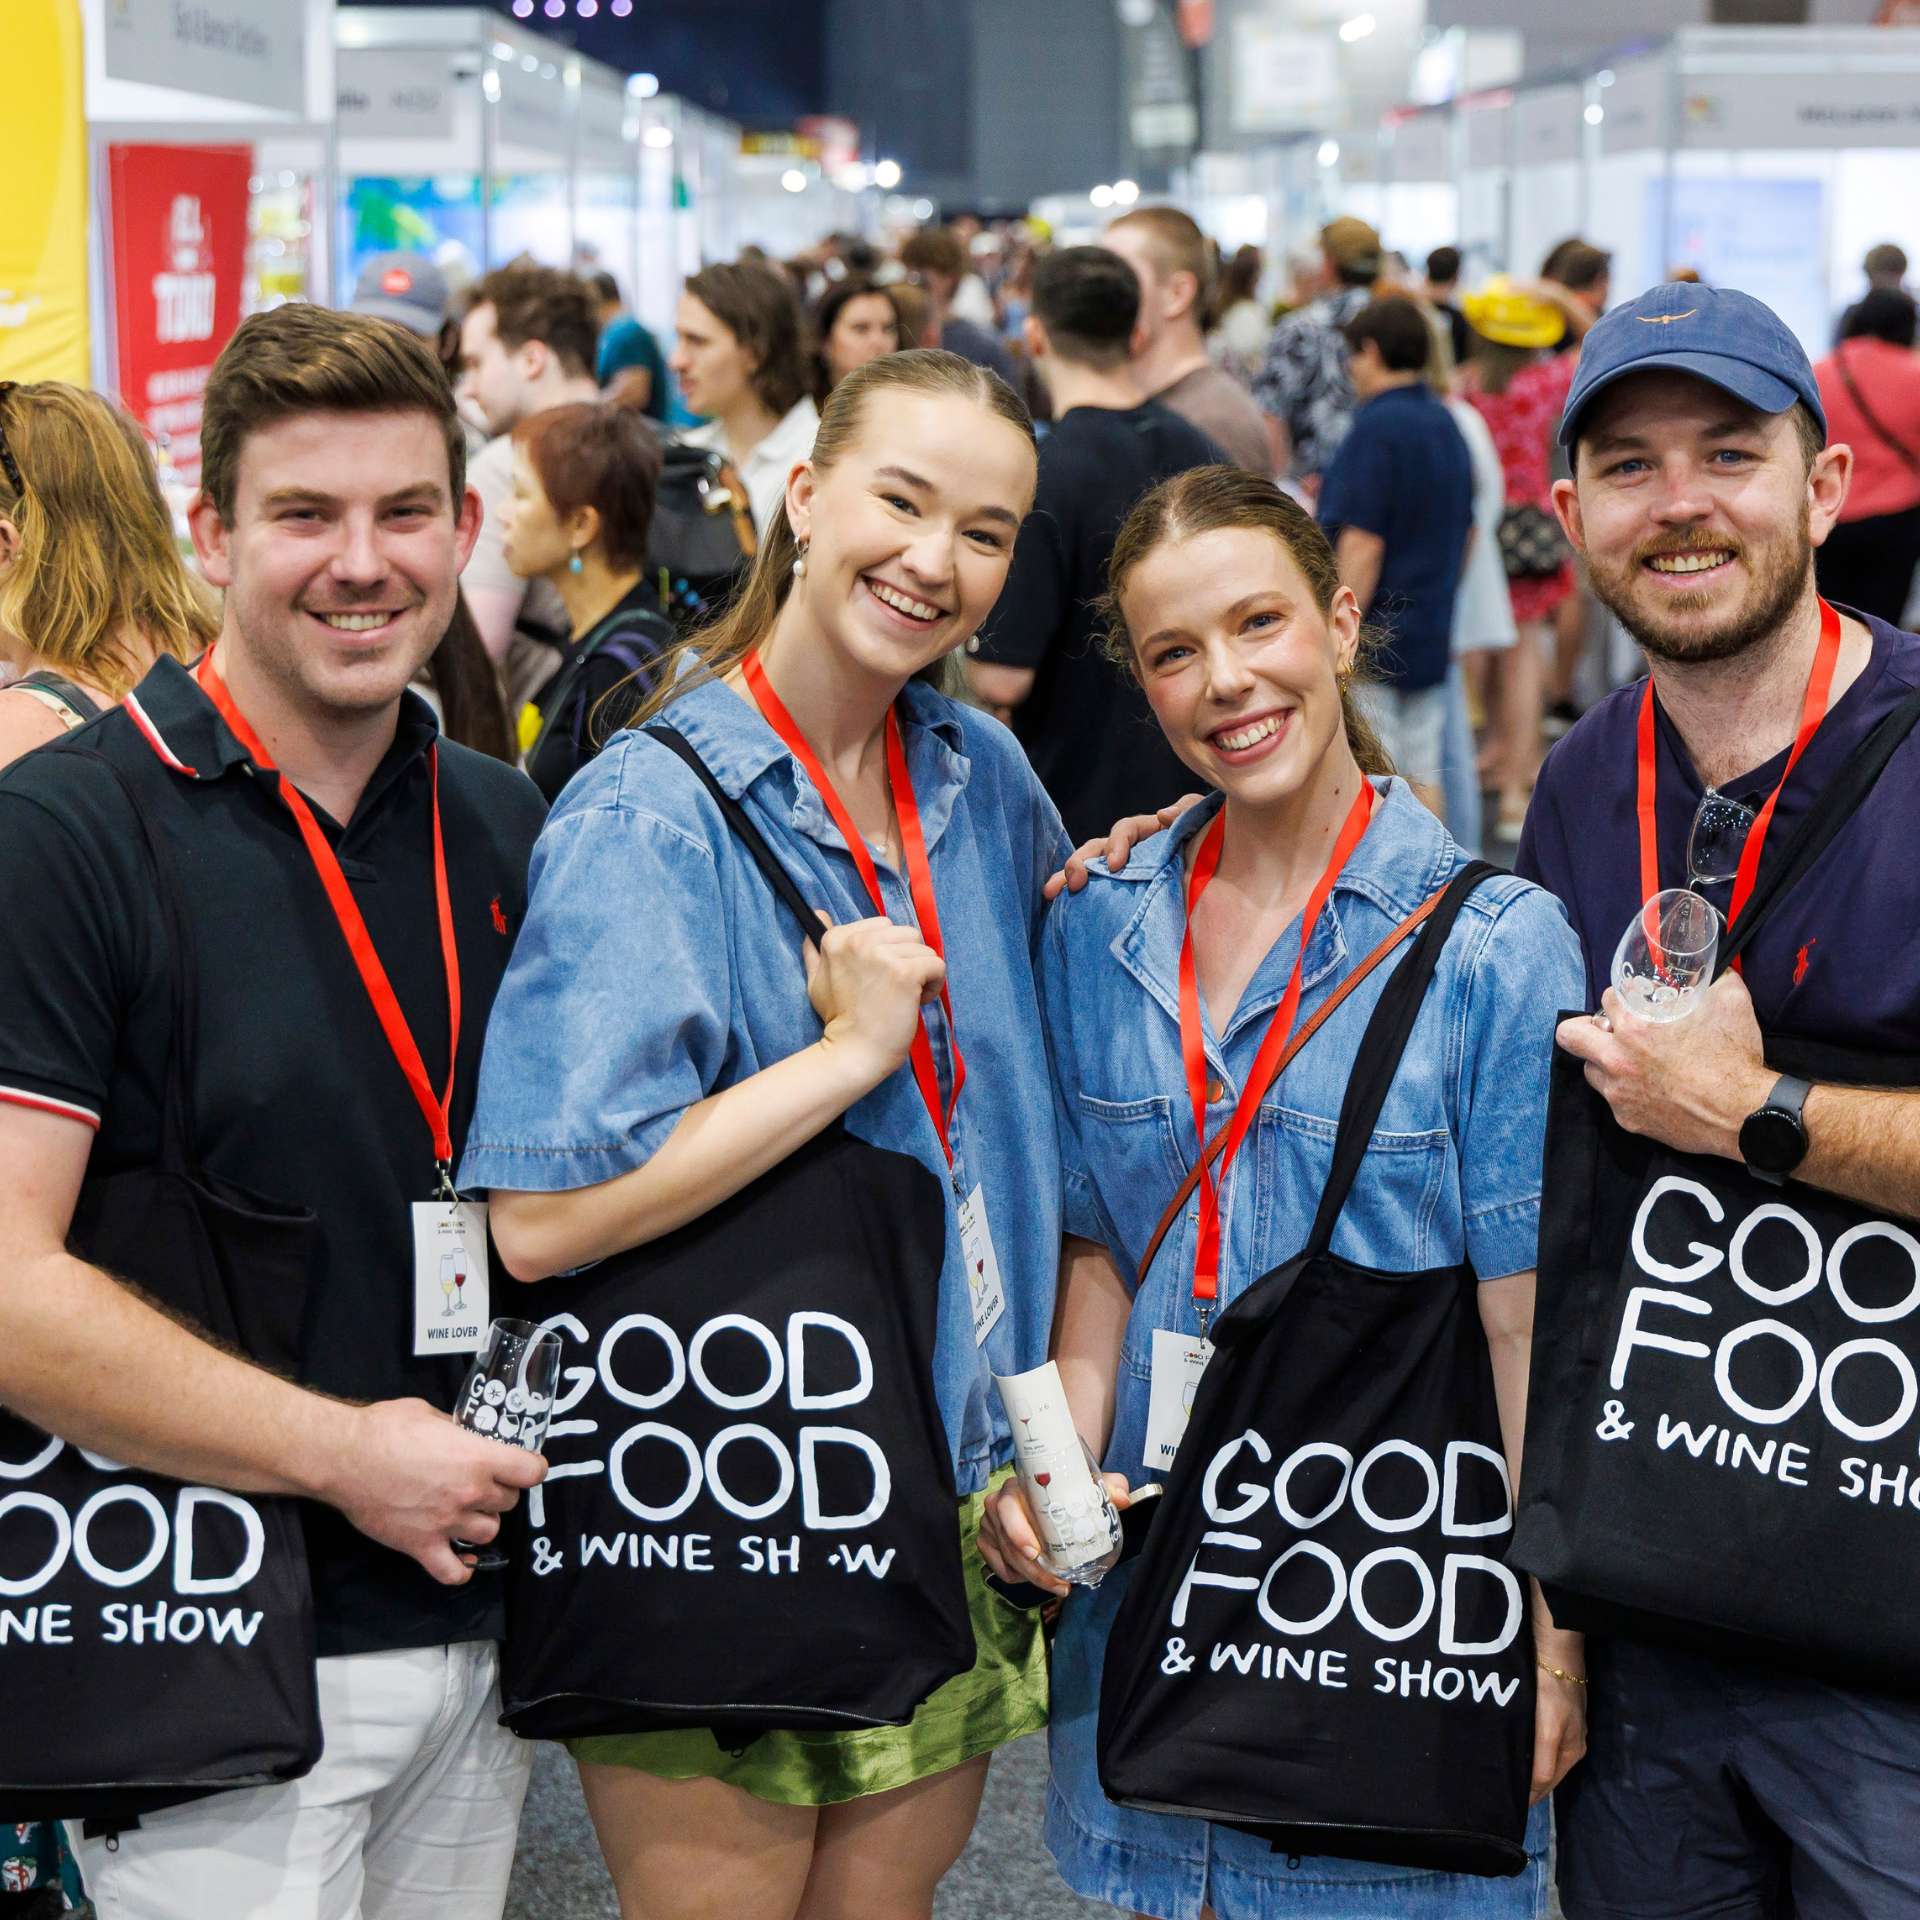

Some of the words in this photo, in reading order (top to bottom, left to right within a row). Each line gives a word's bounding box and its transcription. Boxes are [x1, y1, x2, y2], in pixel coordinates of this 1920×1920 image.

[1632, 1176, 1920, 1323] GOO
[427, 1328, 449, 1340] WINE
[452, 1326, 479, 1339] LOVER
[984, 1295, 999, 1320] LOVER
[518, 1312, 873, 1412] GOOD
[1610, 1287, 1920, 1442] FOO
[527, 1421, 891, 1530] FOOD
[1161, 1444, 1175, 1457] WI
[1202, 1429, 1513, 1537] GOOD
[1596, 1400, 1635, 1441] &
[1657, 1414, 1810, 1486] WINE
[1839, 1457, 1920, 1510] SH
[0, 1484, 265, 1596] OOD
[531, 1536, 563, 1577] &
[580, 1533, 715, 1571] WINE
[739, 1535, 896, 1579] SHW
[0, 1604, 74, 1645] NE
[101, 1601, 264, 1647] SHOW
[1172, 1532, 1523, 1655] FOOD
[1161, 1638, 1195, 1675] &
[1210, 1643, 1349, 1688] WINE
[1375, 1658, 1521, 1706] SHOW
